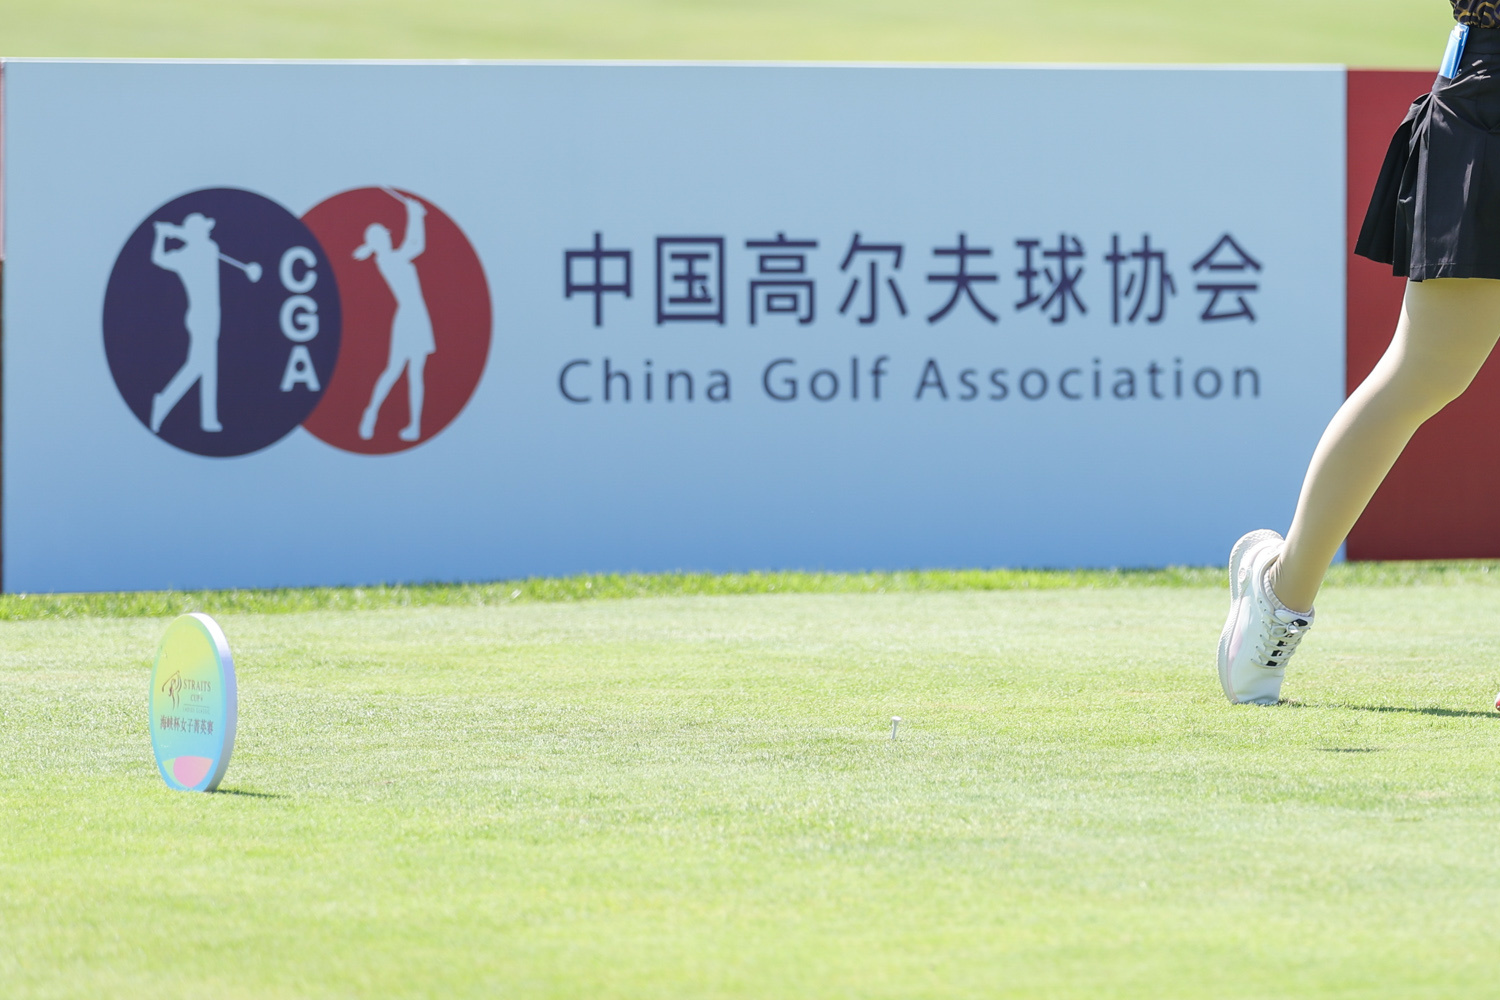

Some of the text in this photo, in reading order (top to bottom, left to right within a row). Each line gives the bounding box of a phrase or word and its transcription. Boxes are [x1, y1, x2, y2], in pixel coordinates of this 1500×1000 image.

[563, 231, 1263, 327] 中国高尔夫球协会
[279, 246, 321, 393] CGA
[557, 355, 1262, 404] China Golf Association
[183, 679, 211, 692] STRAITS
